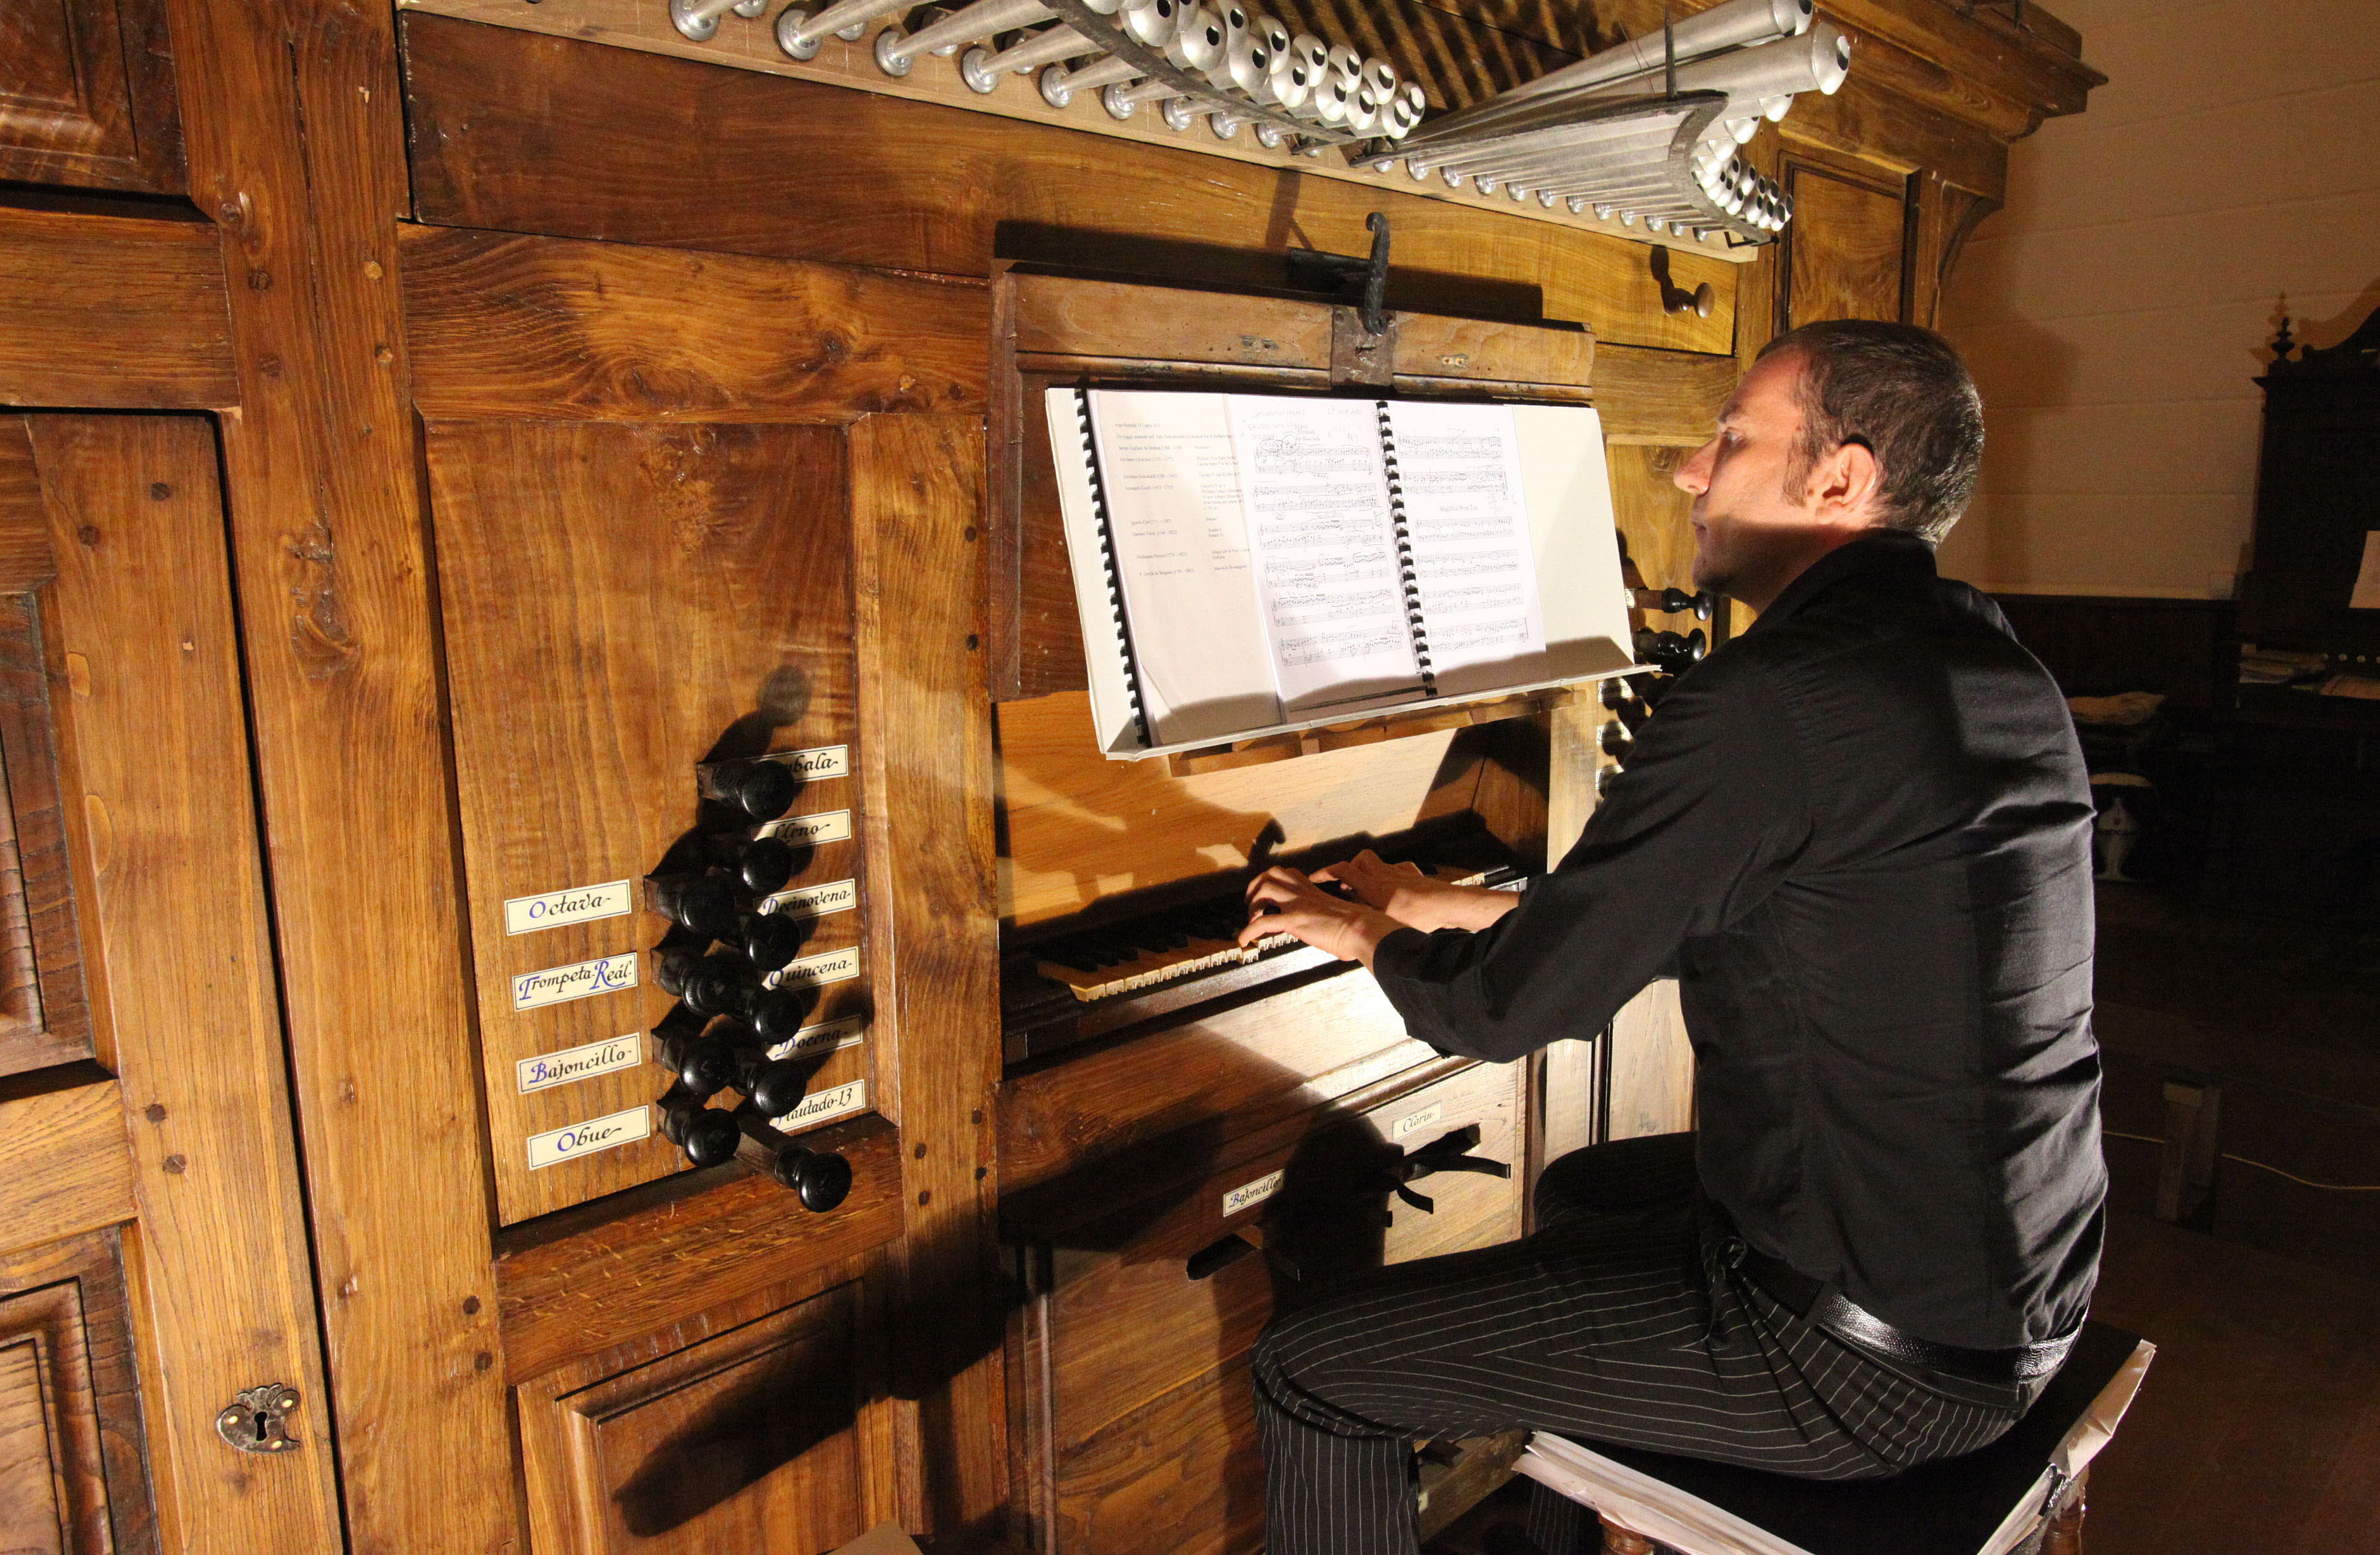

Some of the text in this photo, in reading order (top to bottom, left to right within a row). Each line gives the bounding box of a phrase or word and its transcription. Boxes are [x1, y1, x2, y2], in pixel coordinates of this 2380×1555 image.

[770, 960, 852, 987] Quincena
[527, 1045, 632, 1085] Bajoncillo
[557, 1127, 623, 1152] Obue
[1228, 1176, 1281, 1208] Bajoncillo
